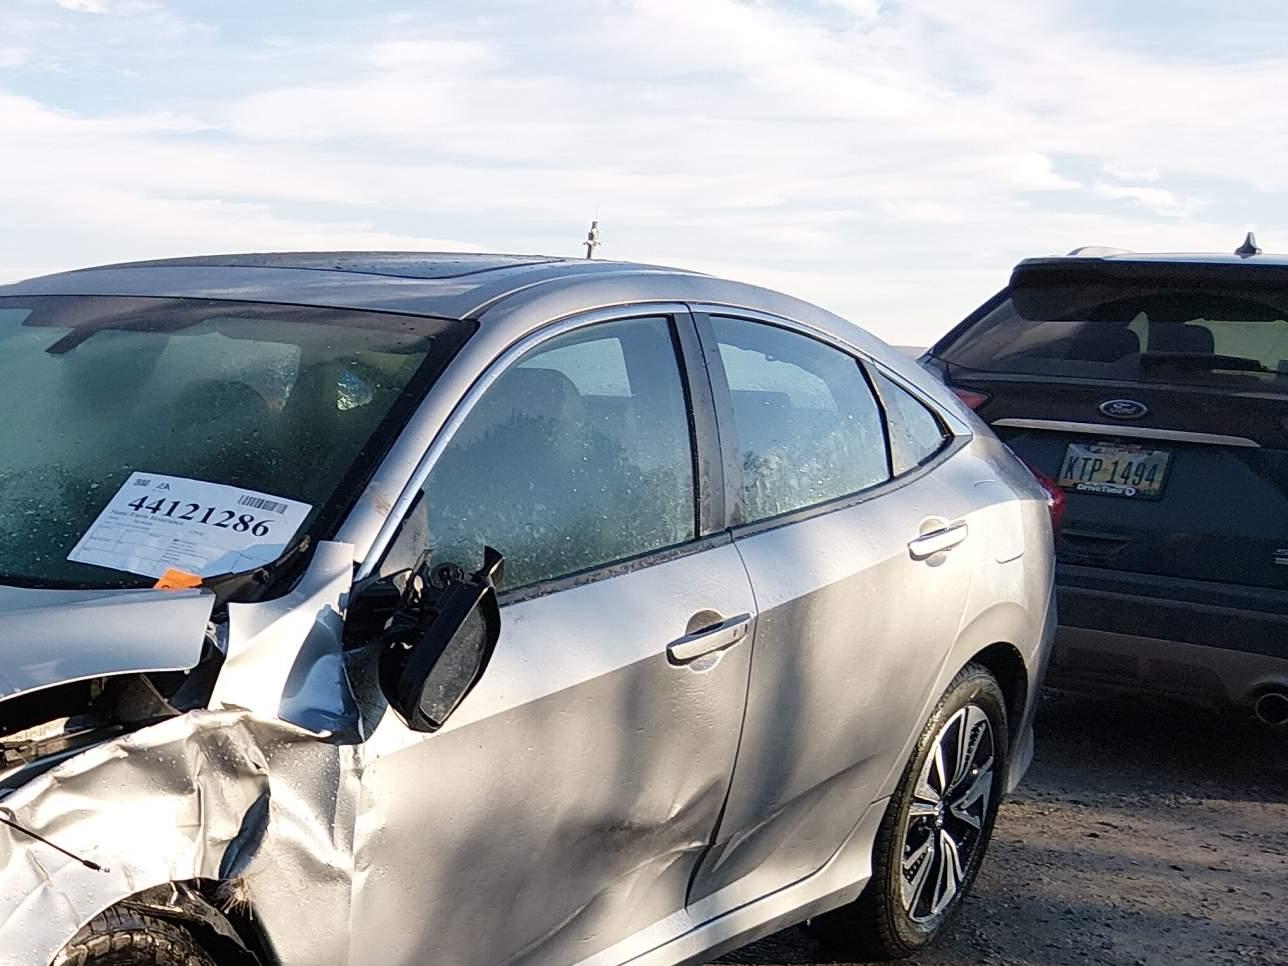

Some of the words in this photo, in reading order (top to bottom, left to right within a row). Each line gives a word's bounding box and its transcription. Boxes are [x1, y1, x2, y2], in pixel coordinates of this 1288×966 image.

[1064, 455, 1103, 481] KTP
[1106, 459, 1159, 486] 1494
[128, 494, 276, 537] 44121286
